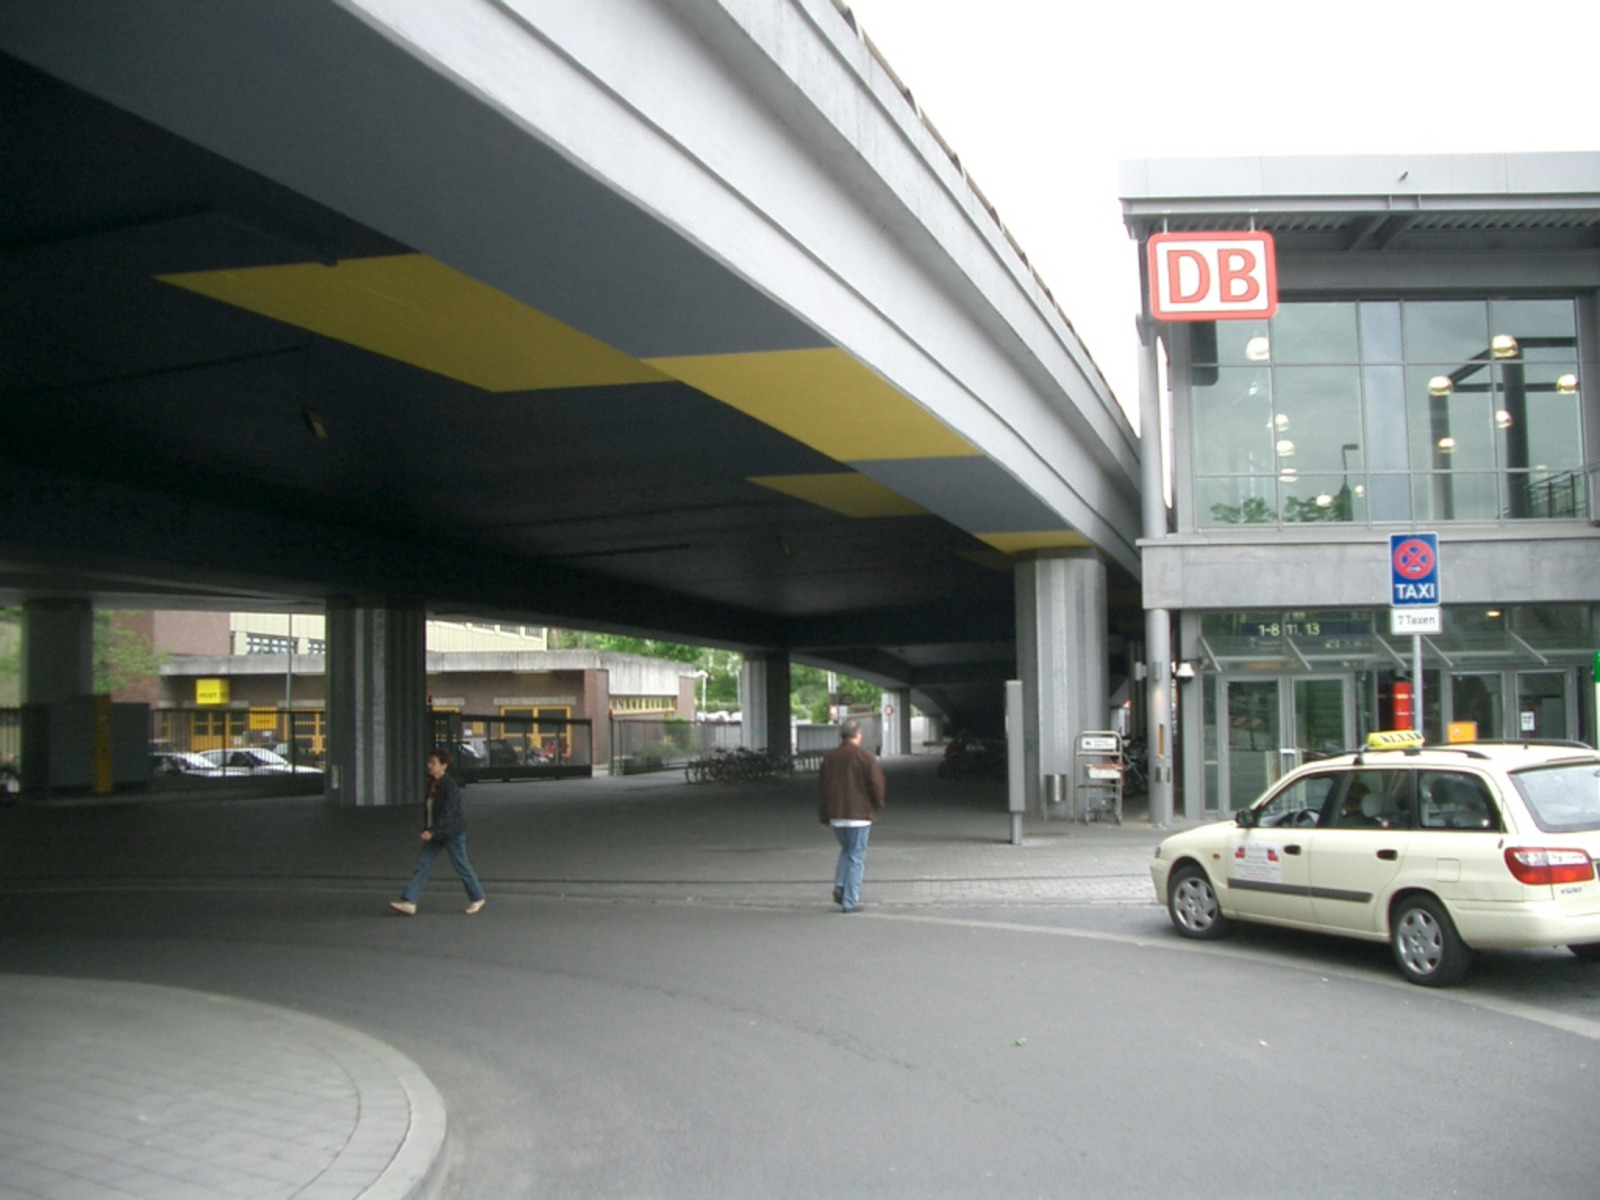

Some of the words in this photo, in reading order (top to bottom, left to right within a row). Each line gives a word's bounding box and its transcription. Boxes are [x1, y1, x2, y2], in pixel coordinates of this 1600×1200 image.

[1167, 248, 1260, 304] DB
[1395, 583, 1435, 599] TAXI
[1398, 615, 1404, 625] 7
[1405, 614, 1436, 625] Taxen
[1305, 622, 1320, 635] 13
